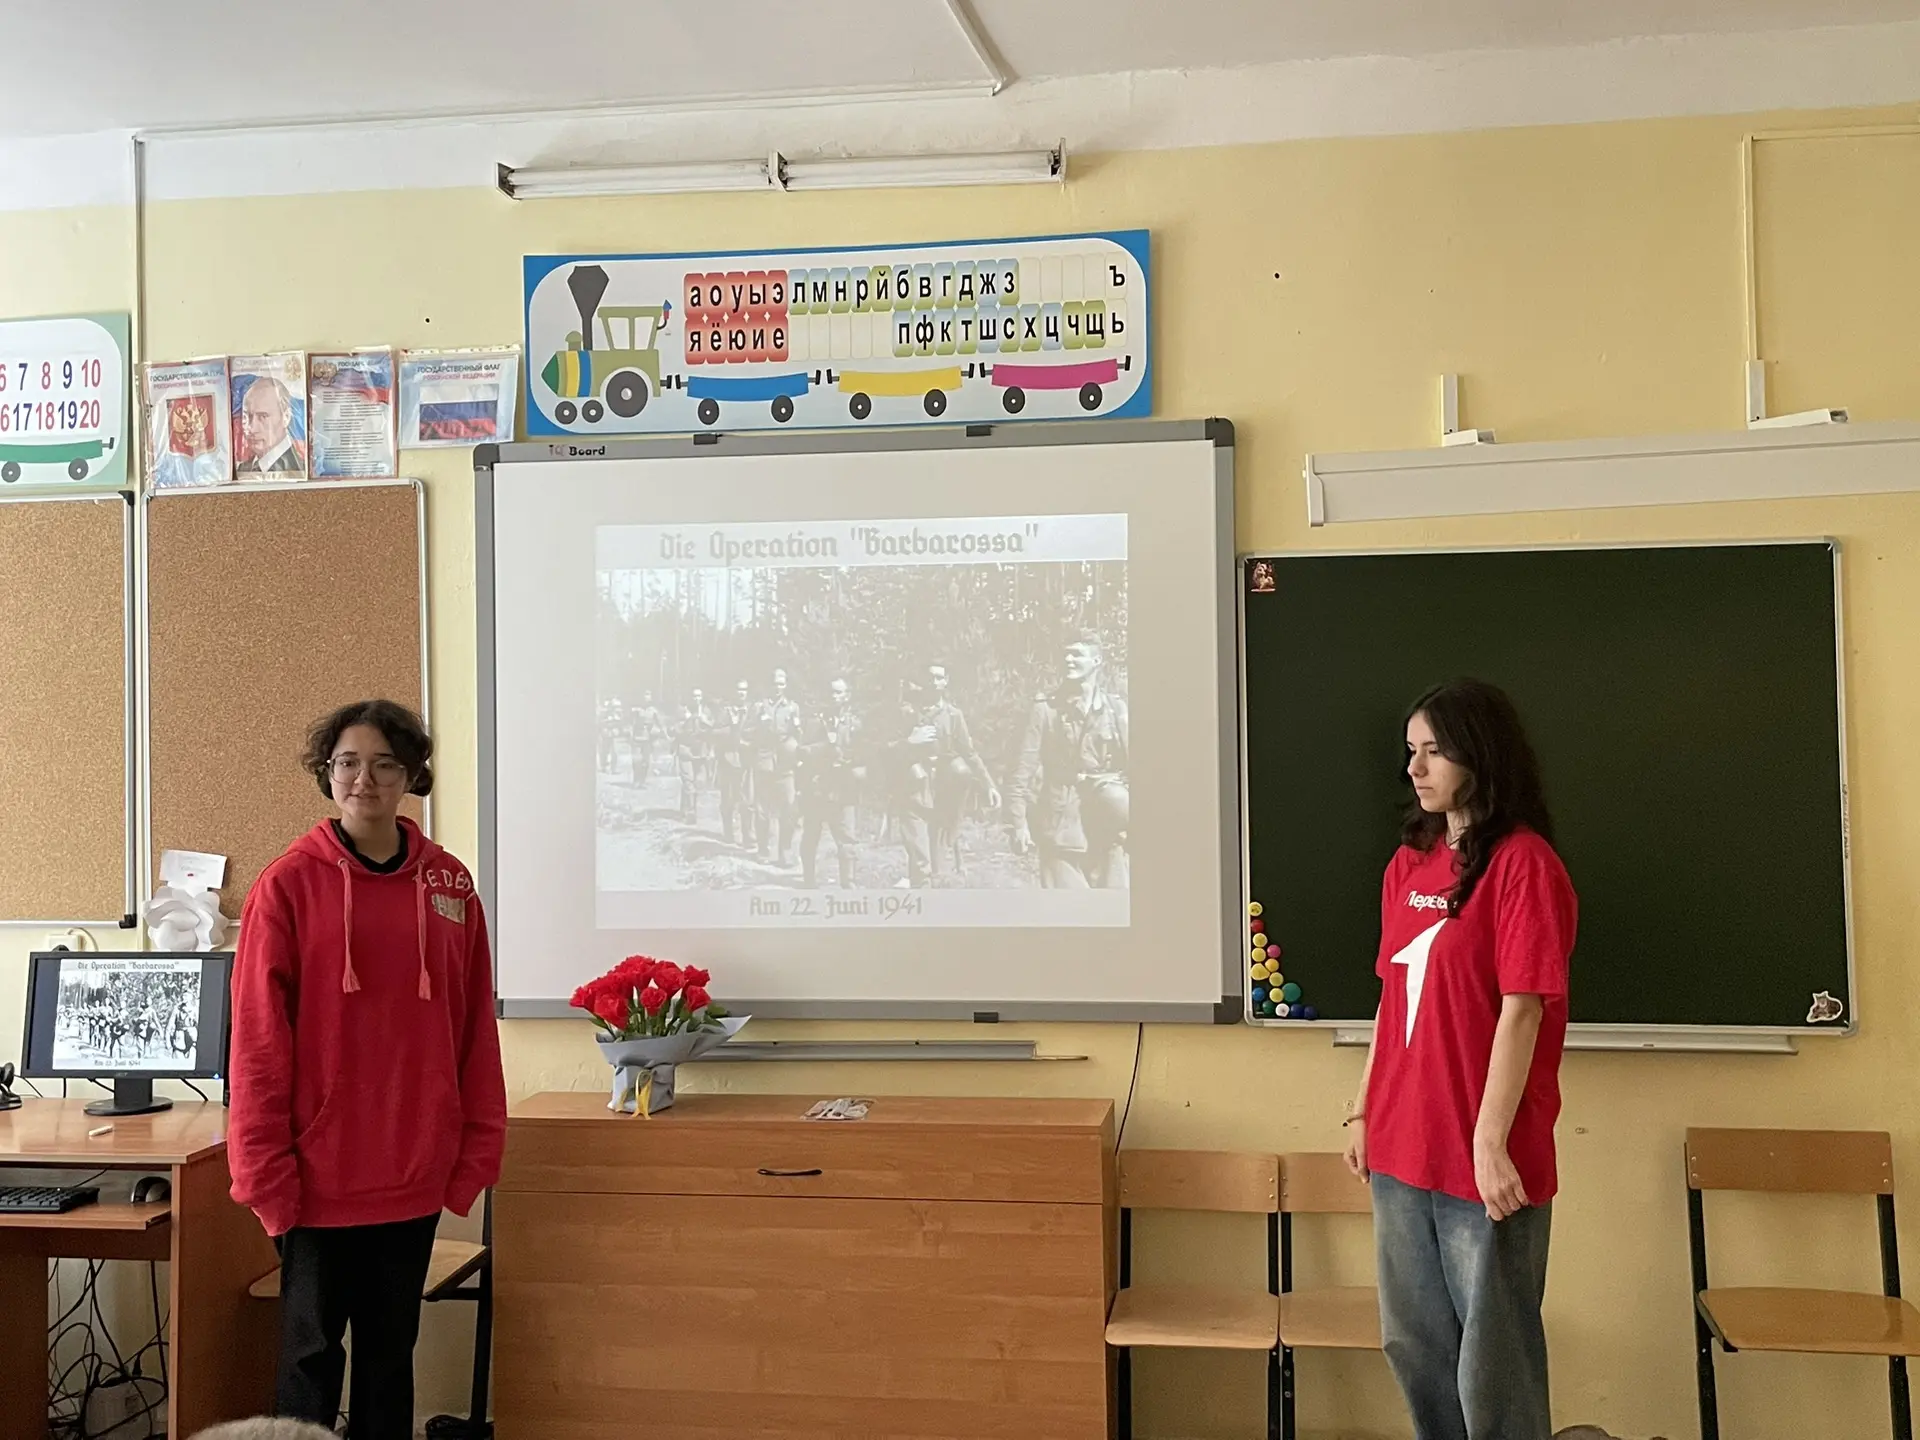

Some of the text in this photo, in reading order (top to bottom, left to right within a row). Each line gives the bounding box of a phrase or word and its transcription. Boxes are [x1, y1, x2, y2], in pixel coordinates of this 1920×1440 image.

[690, 286, 701, 307] а
[710, 285, 722, 306] о
[732, 285, 743, 313] у
[750, 284, 766, 305] ы
[773, 283, 784, 304] э
[792, 282, 806, 303] л
[813, 282, 827, 302] м
[836, 281, 847, 301] н
[857, 279, 868, 308] р
[877, 271, 888, 300] й
[897, 269, 910, 298] б
[920, 277, 931, 297] в
[943, 275, 952, 297] г
[959, 275, 973, 301] д
[980, 273, 996, 295] ж
[1004, 272, 1015, 293] з
[690, 312, 1124, 352] я ё ю и е п ф к т ш с х ц ч щ ь
[0, 359, 101, 392] 6 7 8 9 10
[13, 403, 32, 431] 17
[35, 401, 55, 430] 18
[58, 400, 77, 429] 19
[79, 399, 101, 429] 20
[569, 445, 605, 456] Board
[660, 523, 1039, 567] Die Operation "Barbarossa"
[749, 895, 781, 916] Am
[824, 894, 868, 919] Juni
[878, 893, 922, 921] 1941
